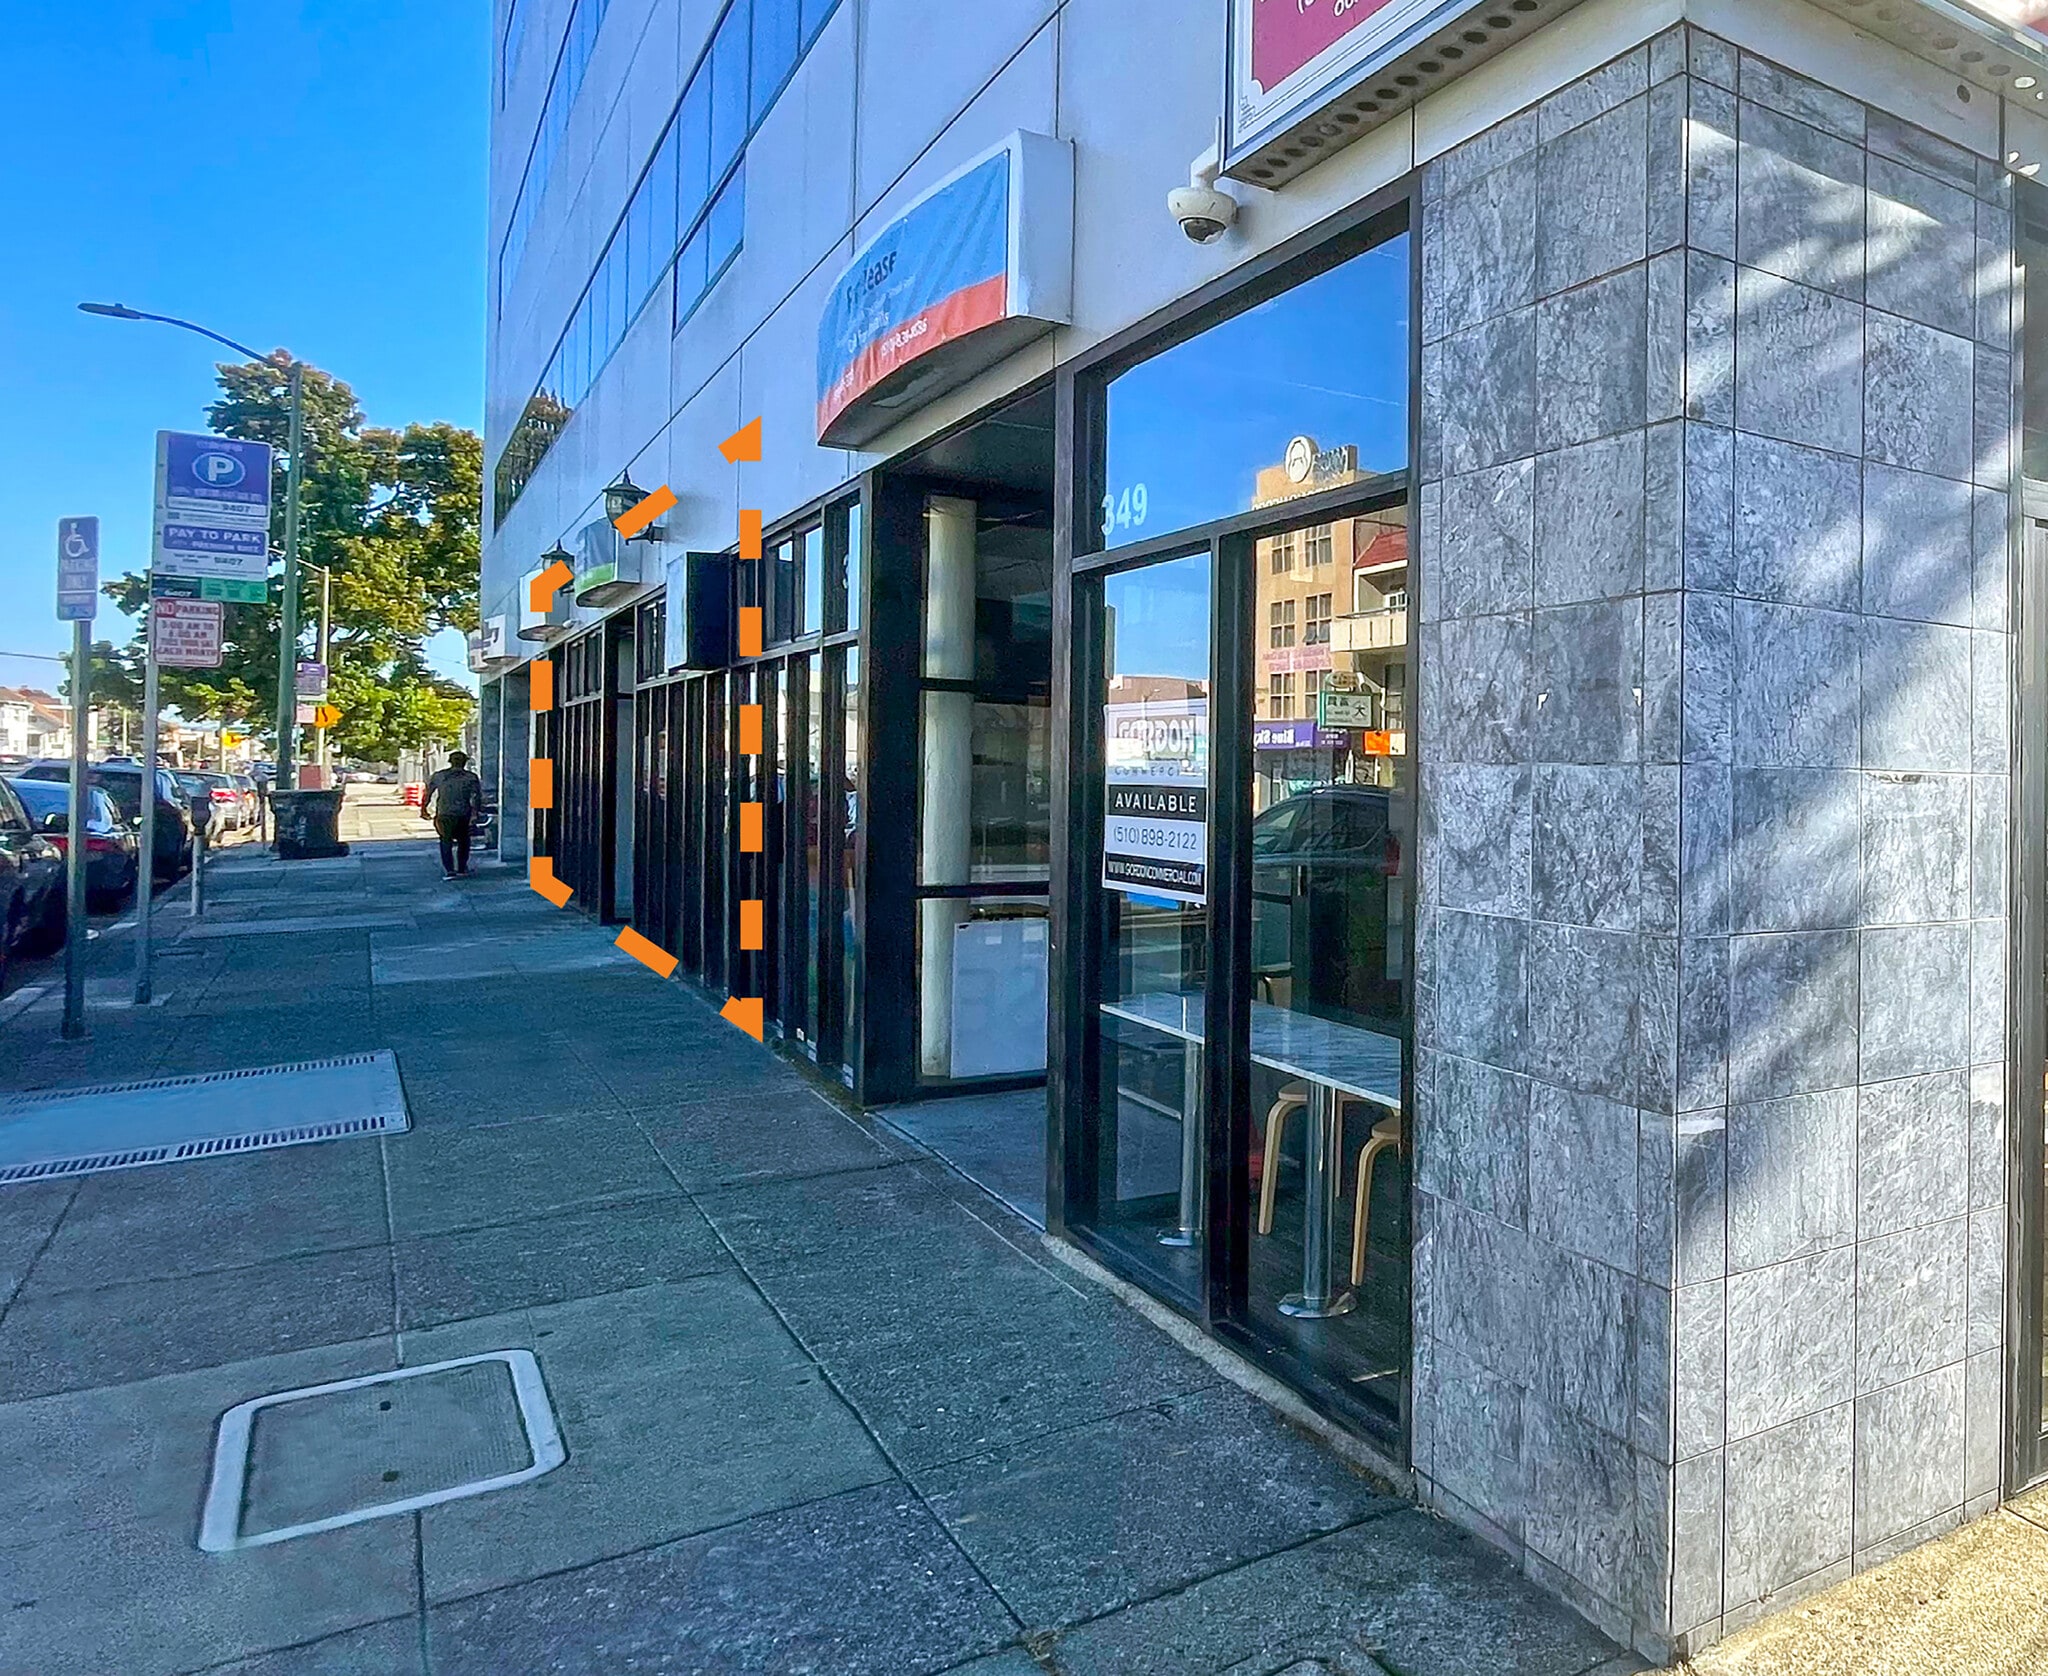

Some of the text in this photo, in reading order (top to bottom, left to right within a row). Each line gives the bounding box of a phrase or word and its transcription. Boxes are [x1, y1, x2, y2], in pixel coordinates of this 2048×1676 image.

[208, 456, 235, 482] P
[1101, 483, 1148, 536] 349
[168, 527, 262, 544] PAY TO PARK
[156, 601, 219, 616] NO PARKING
[1114, 792, 1197, 814] AVAILABLE
